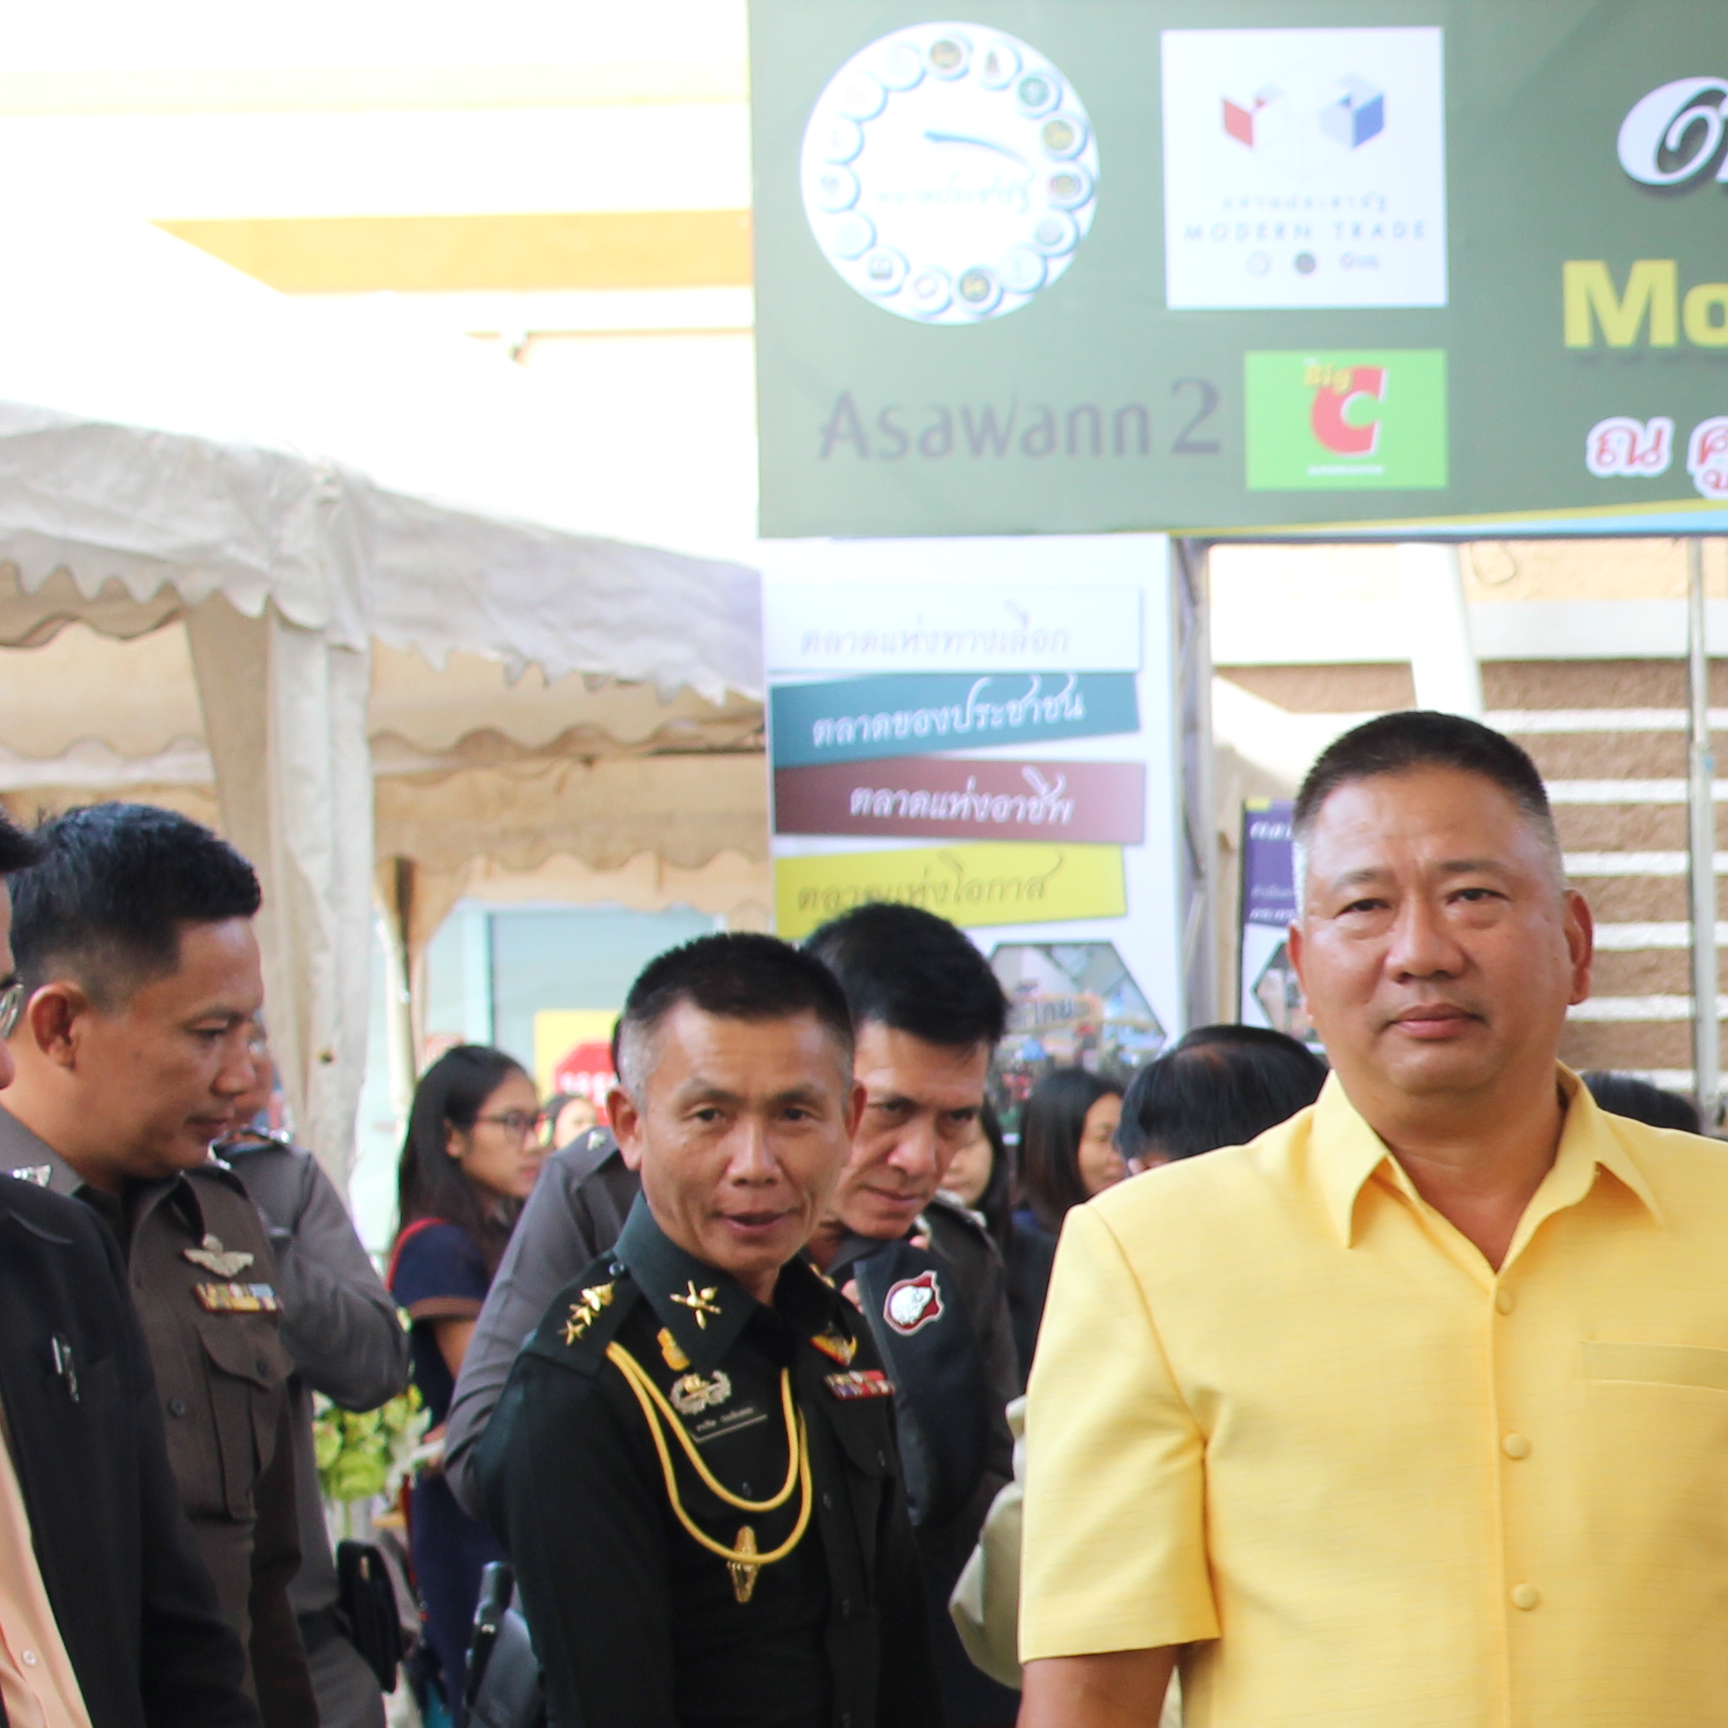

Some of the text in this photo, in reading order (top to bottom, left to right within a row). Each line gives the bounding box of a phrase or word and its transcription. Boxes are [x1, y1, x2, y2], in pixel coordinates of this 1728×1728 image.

[1184, 219, 1426, 242] MODERN TRADE
[1304, 363, 1353, 394] Big
[817, 376, 1220, 462] Asawann 2
[1310, 364, 1387, 458] C
[1590, 420, 1668, 473] ณ
[812, 672, 1086, 748] ตลาดของประชาชน
[849, 764, 1075, 826] ตลาดแห่งอาชีพ
